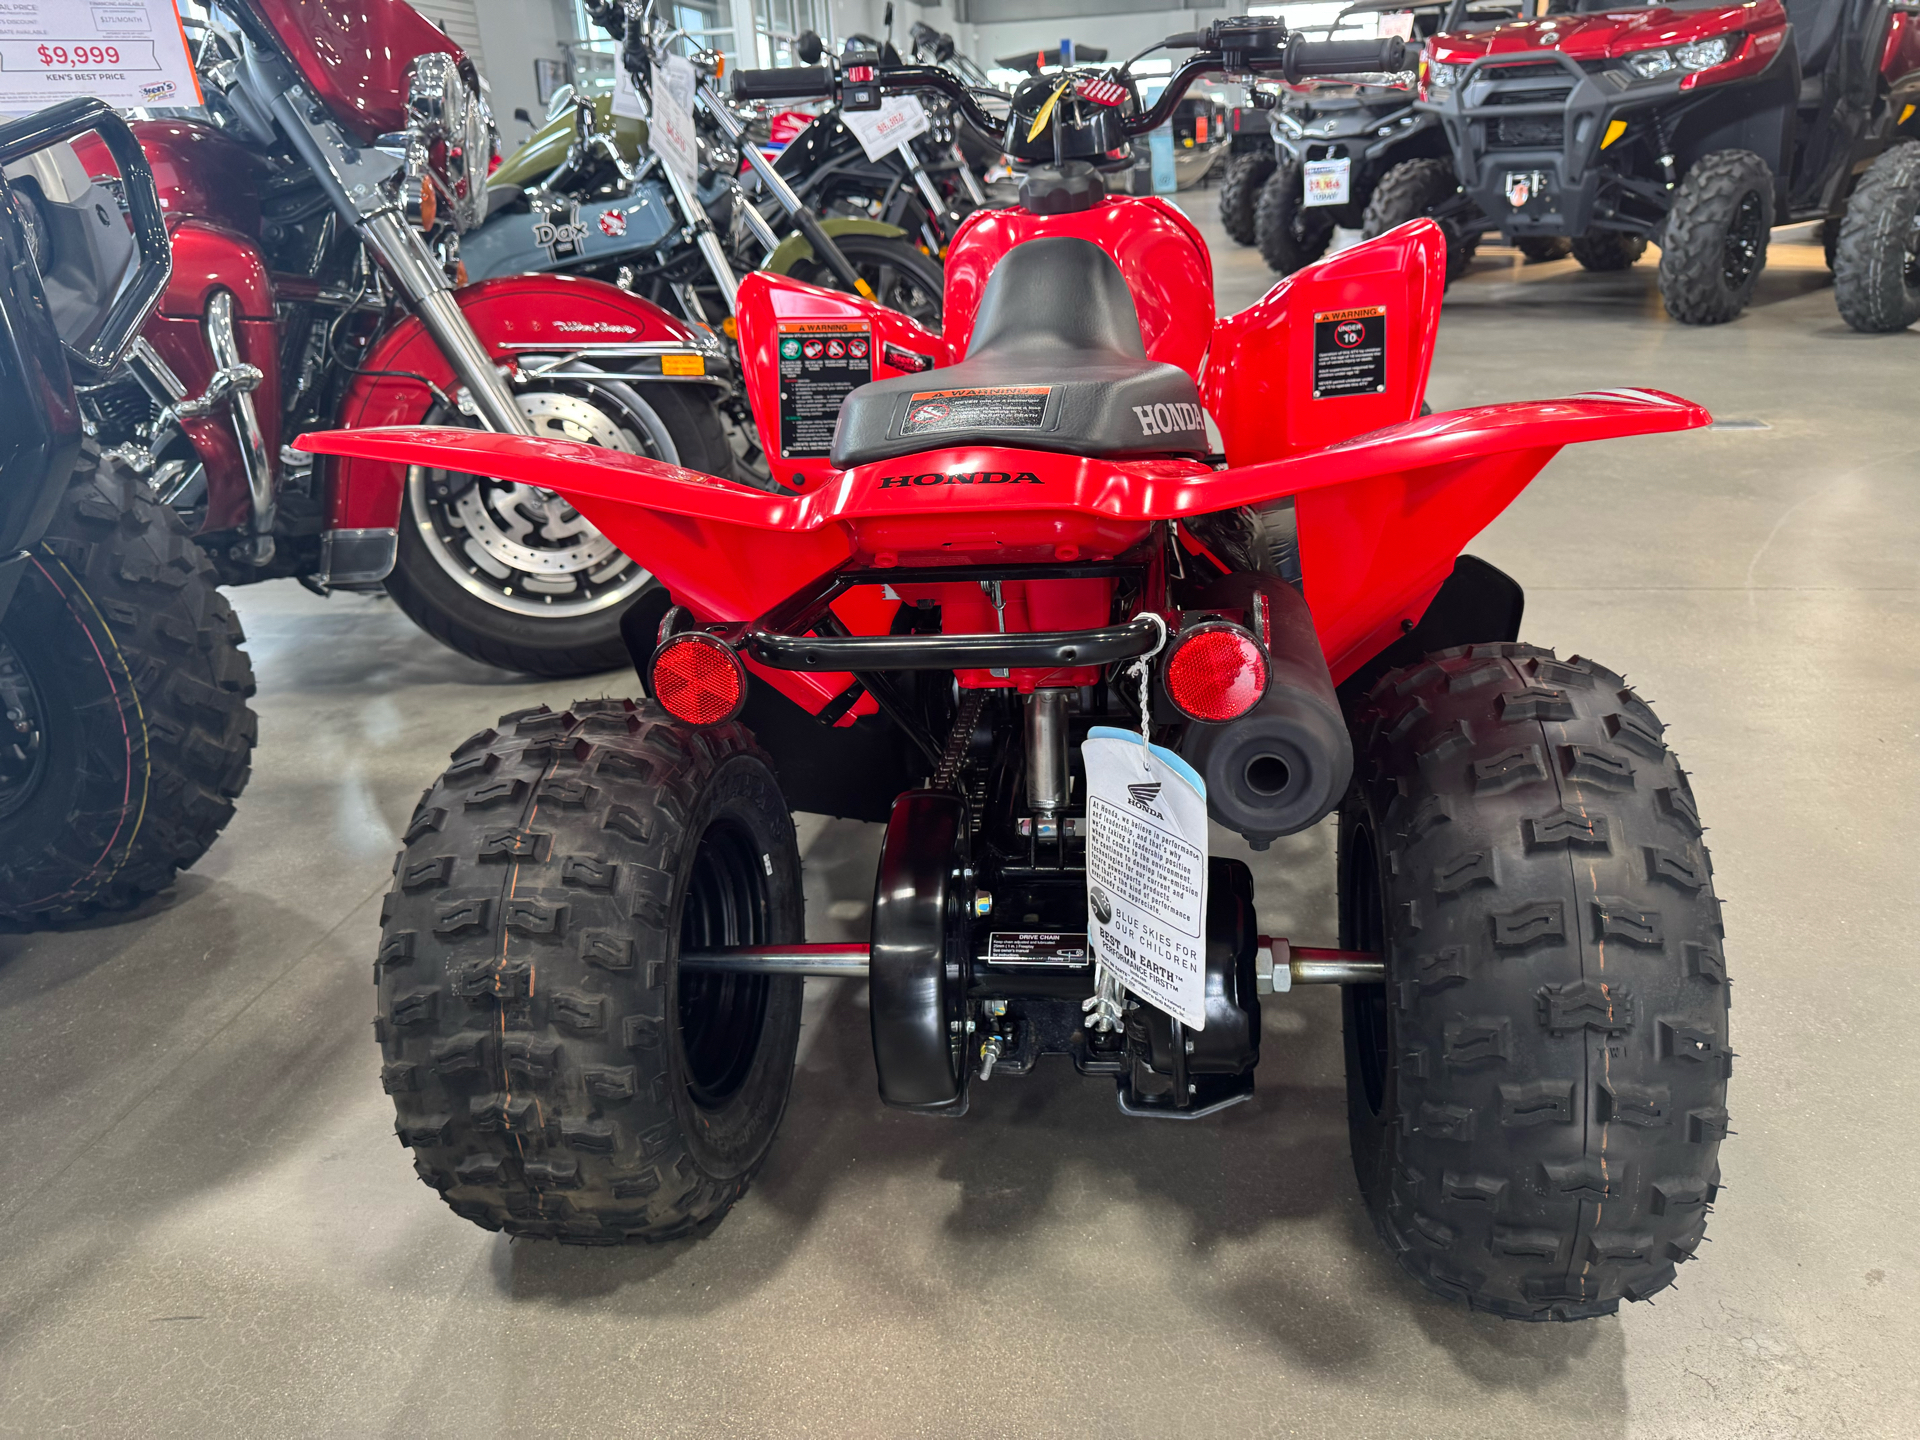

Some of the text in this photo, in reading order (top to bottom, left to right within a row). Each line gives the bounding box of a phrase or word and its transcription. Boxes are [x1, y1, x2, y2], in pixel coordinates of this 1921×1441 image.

[37, 44, 120, 67] $9,999
[532, 221, 590, 248] Dax
[1332, 308, 1377, 319] WARNING
[1338, 324, 1361, 332] UNDER
[1343, 333, 1357, 343] 10
[1132, 403, 1205, 436] HONDA
[878, 472, 1045, 489] HONDA
[1093, 801, 1098, 809] At
[1101, 805, 1119, 820] Honda,
[1132, 820, 1151, 836] believe
[1154, 831, 1159, 840] in
[1162, 837, 1199, 860] performance
[1128, 798, 1165, 821] HONDA
[1092, 811, 1181, 861] and leadership, and that's why
[1092, 820, 1106, 831] we're
[1108, 827, 1125, 842] taking
[1133, 840, 1163, 861] leadership
[1165, 858, 1190, 874] position
[1092, 828, 1104, 839] when
[1112, 840, 1129, 853] comes
[1132, 849, 1138, 857] to
[1140, 853, 1149, 863] the
[1152, 860, 1191, 884] environment.
[1092, 835, 1198, 897] We continue to develop low-emission
[1092, 844, 1184, 899] technologies for our current and
[1092, 851, 1171, 902] future powersports products.
[1091, 869, 1160, 915] everybody can appreciate.
[1092, 860, 1100, 870] And
[1102, 867, 1116, 881] that's
[1119, 877, 1127, 887] the
[1130, 883, 1141, 895] kind
[1152, 897, 1190, 921] performance
[1100, 927, 1120, 949] BEST
[1124, 945, 1136, 960] ON
[1116, 909, 1196, 960] BLUE SKIES FOR
[1116, 921, 1134, 939] OUR
[1140, 936, 1196, 972] CHILDREN
[1103, 941, 1148, 976] PERFORMANCE
